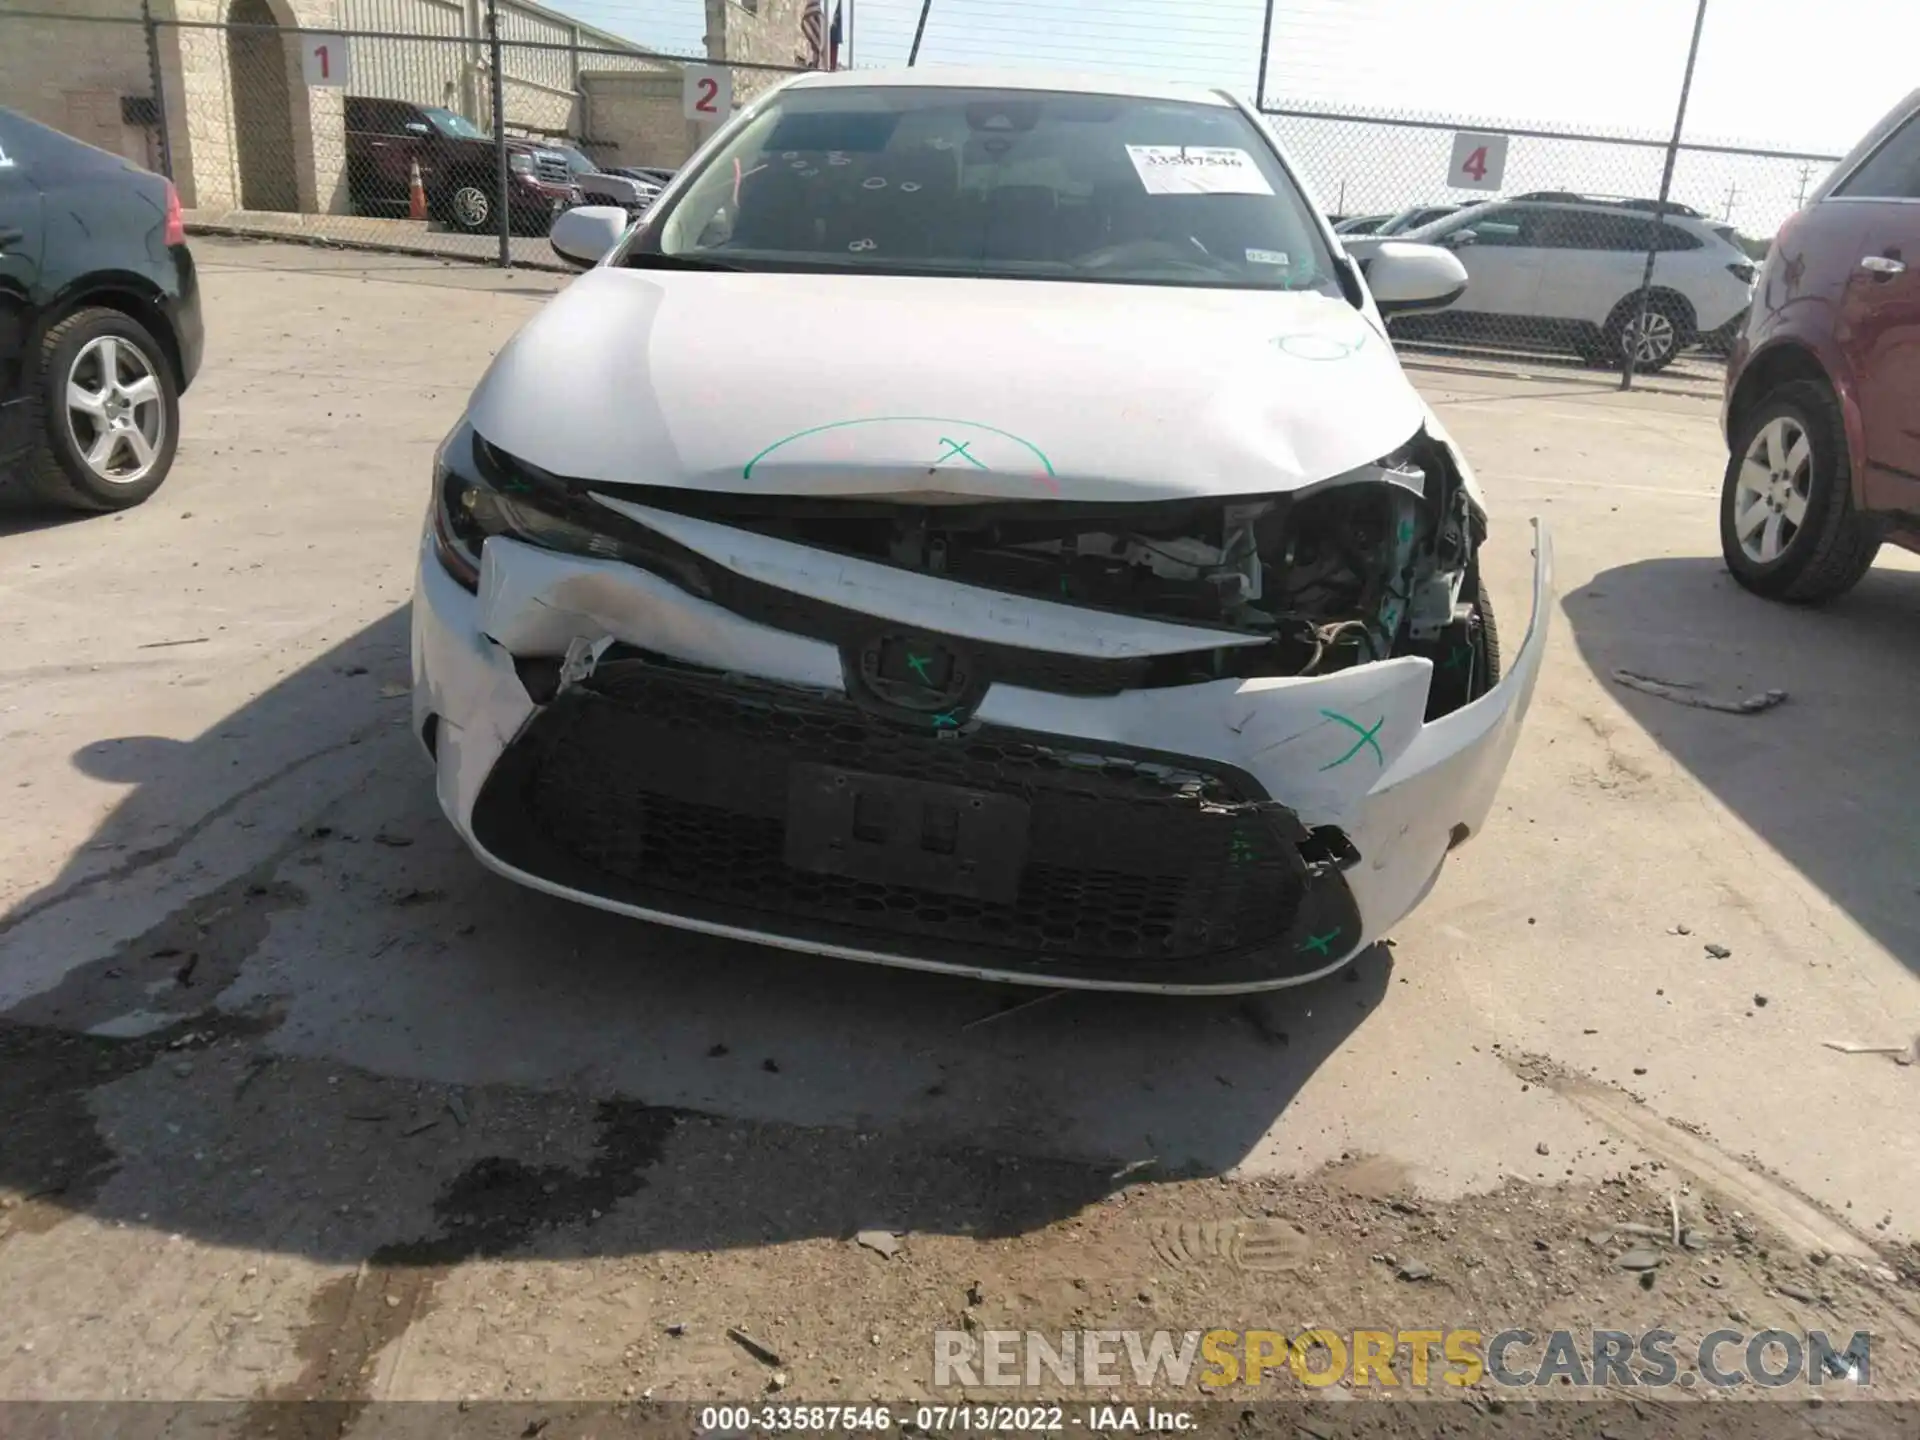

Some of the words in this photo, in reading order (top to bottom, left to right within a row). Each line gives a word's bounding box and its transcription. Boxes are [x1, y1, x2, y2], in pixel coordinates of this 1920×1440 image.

[314, 45, 329, 79] 1
[696, 78, 718, 113] 2
[1462, 146, 1488, 181] 4
